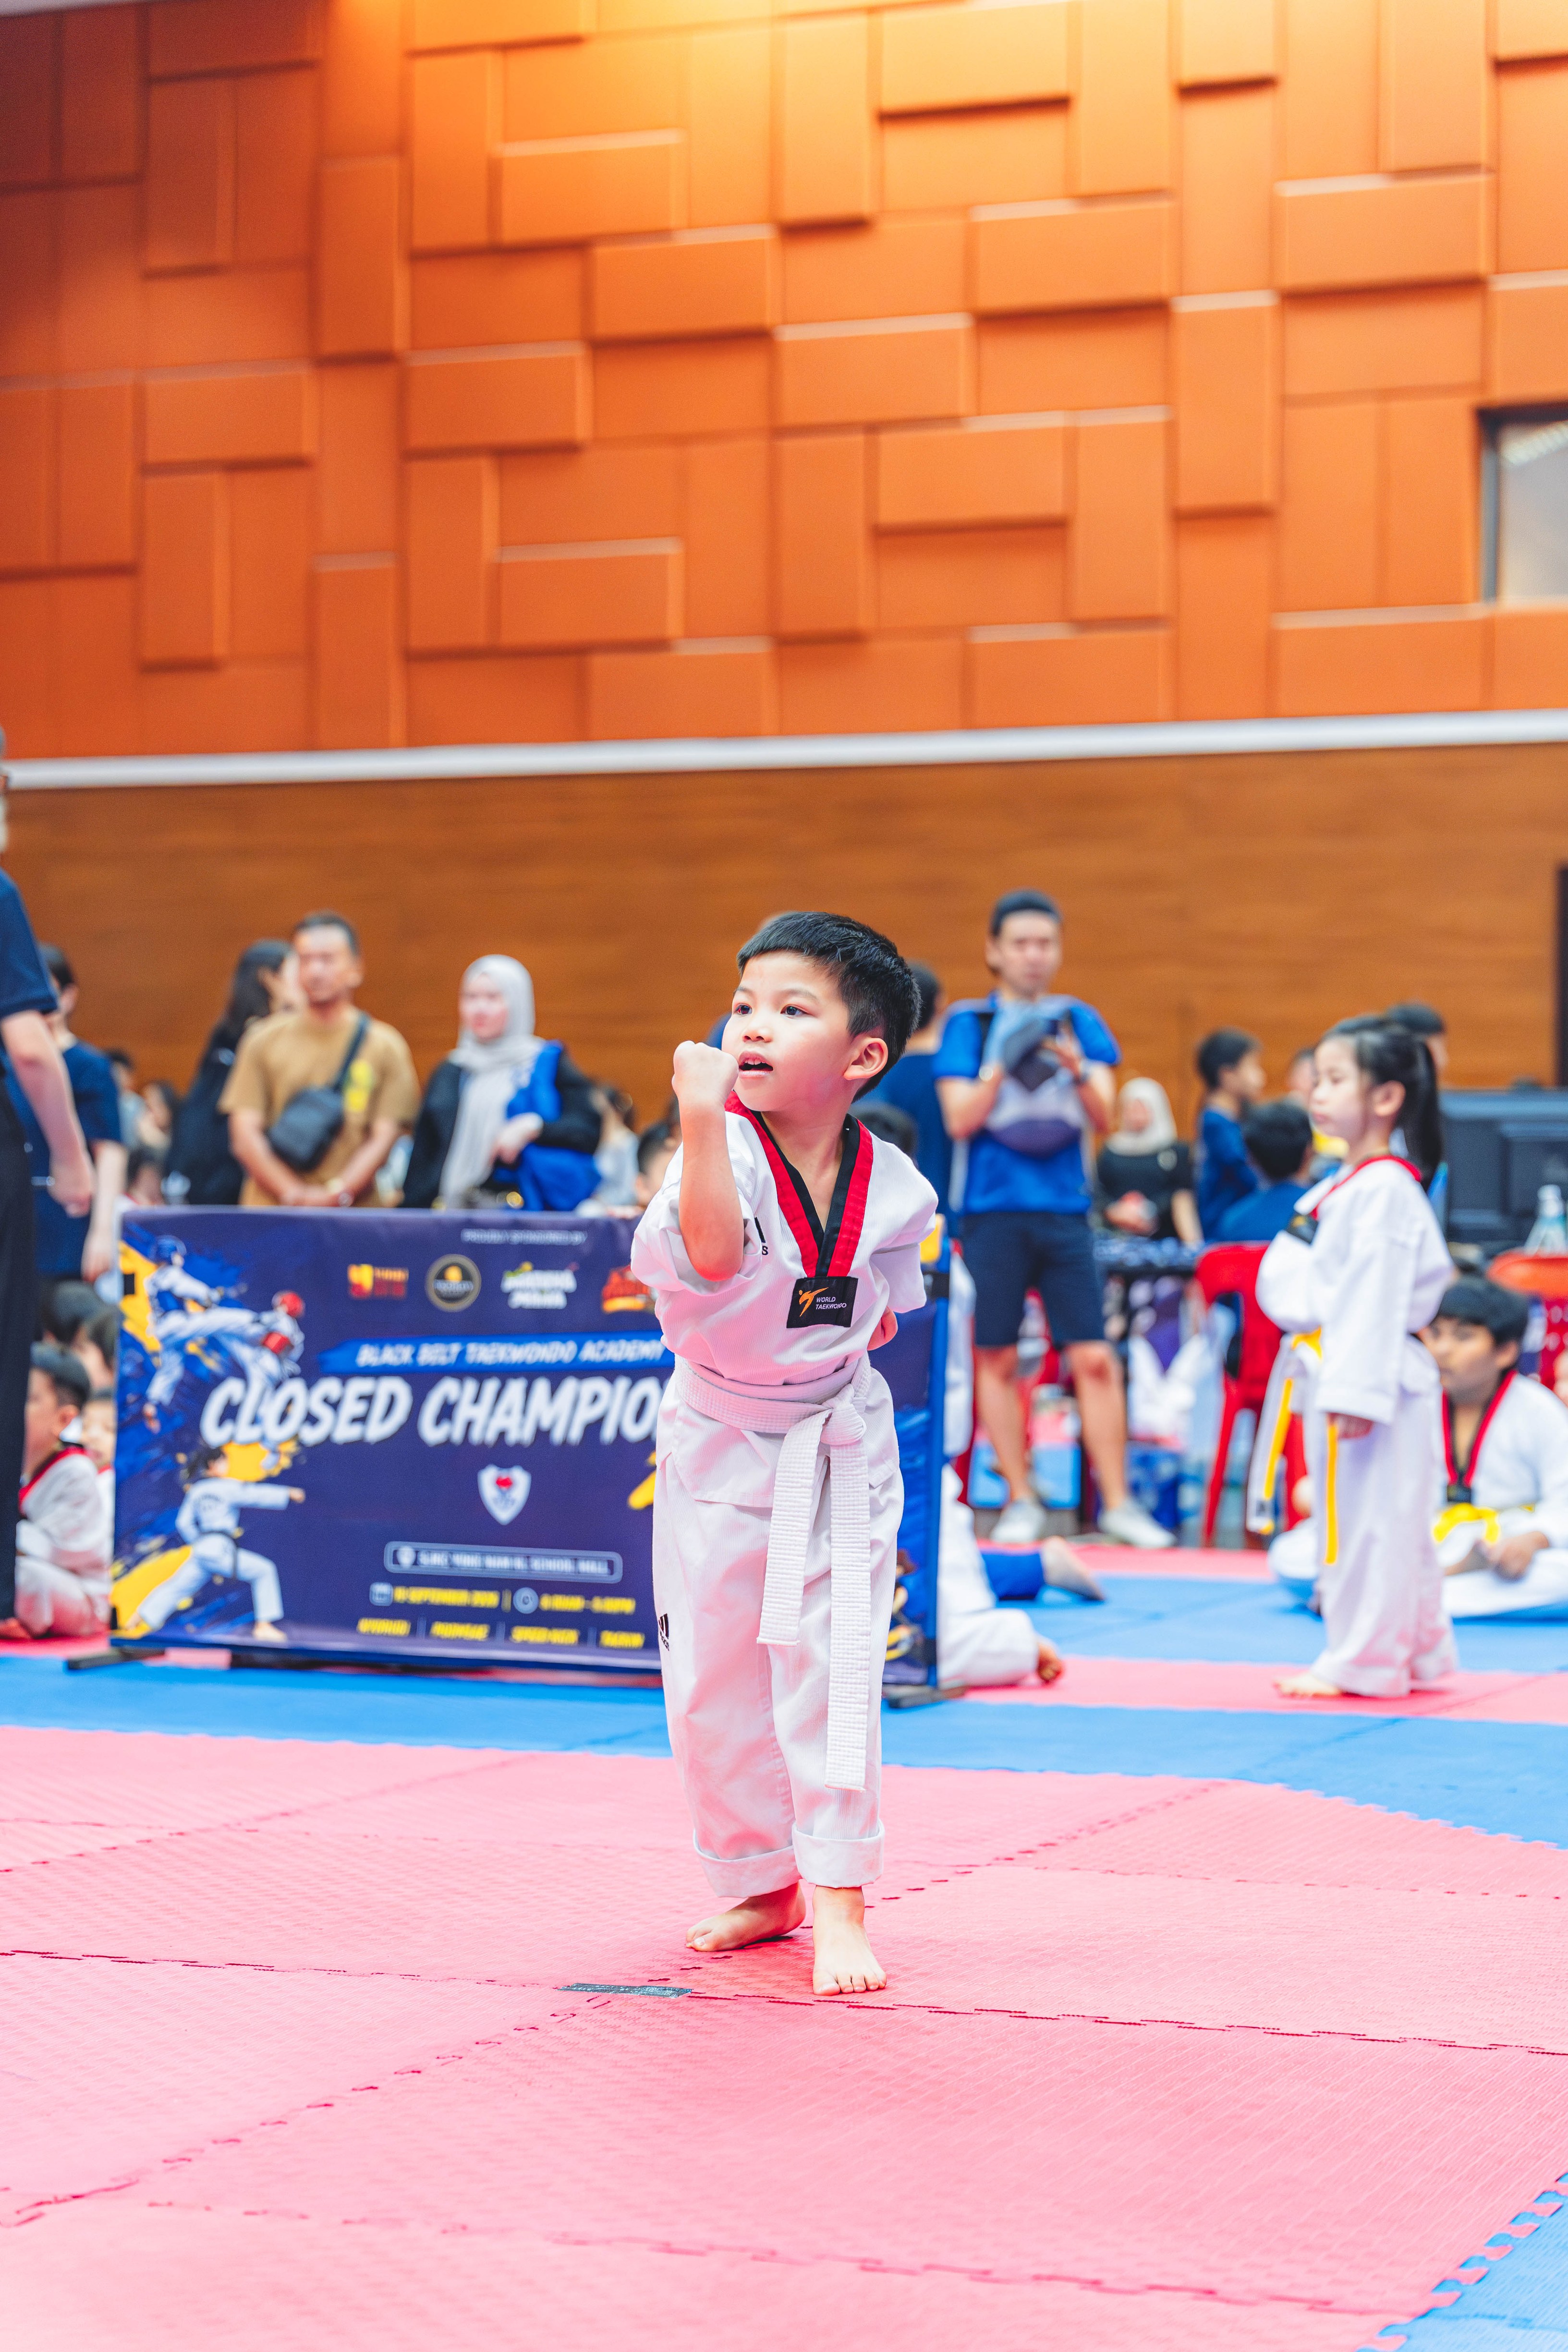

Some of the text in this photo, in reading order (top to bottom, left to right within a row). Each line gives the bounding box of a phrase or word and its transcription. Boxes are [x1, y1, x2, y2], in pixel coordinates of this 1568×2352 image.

[355, 1344, 415, 1367] BLACK
[416, 1343, 464, 1367] BELT
[464, 1341, 578, 1365] TAEKWONDO
[199, 1375, 668, 1448] CLOSED CHAMPIO
